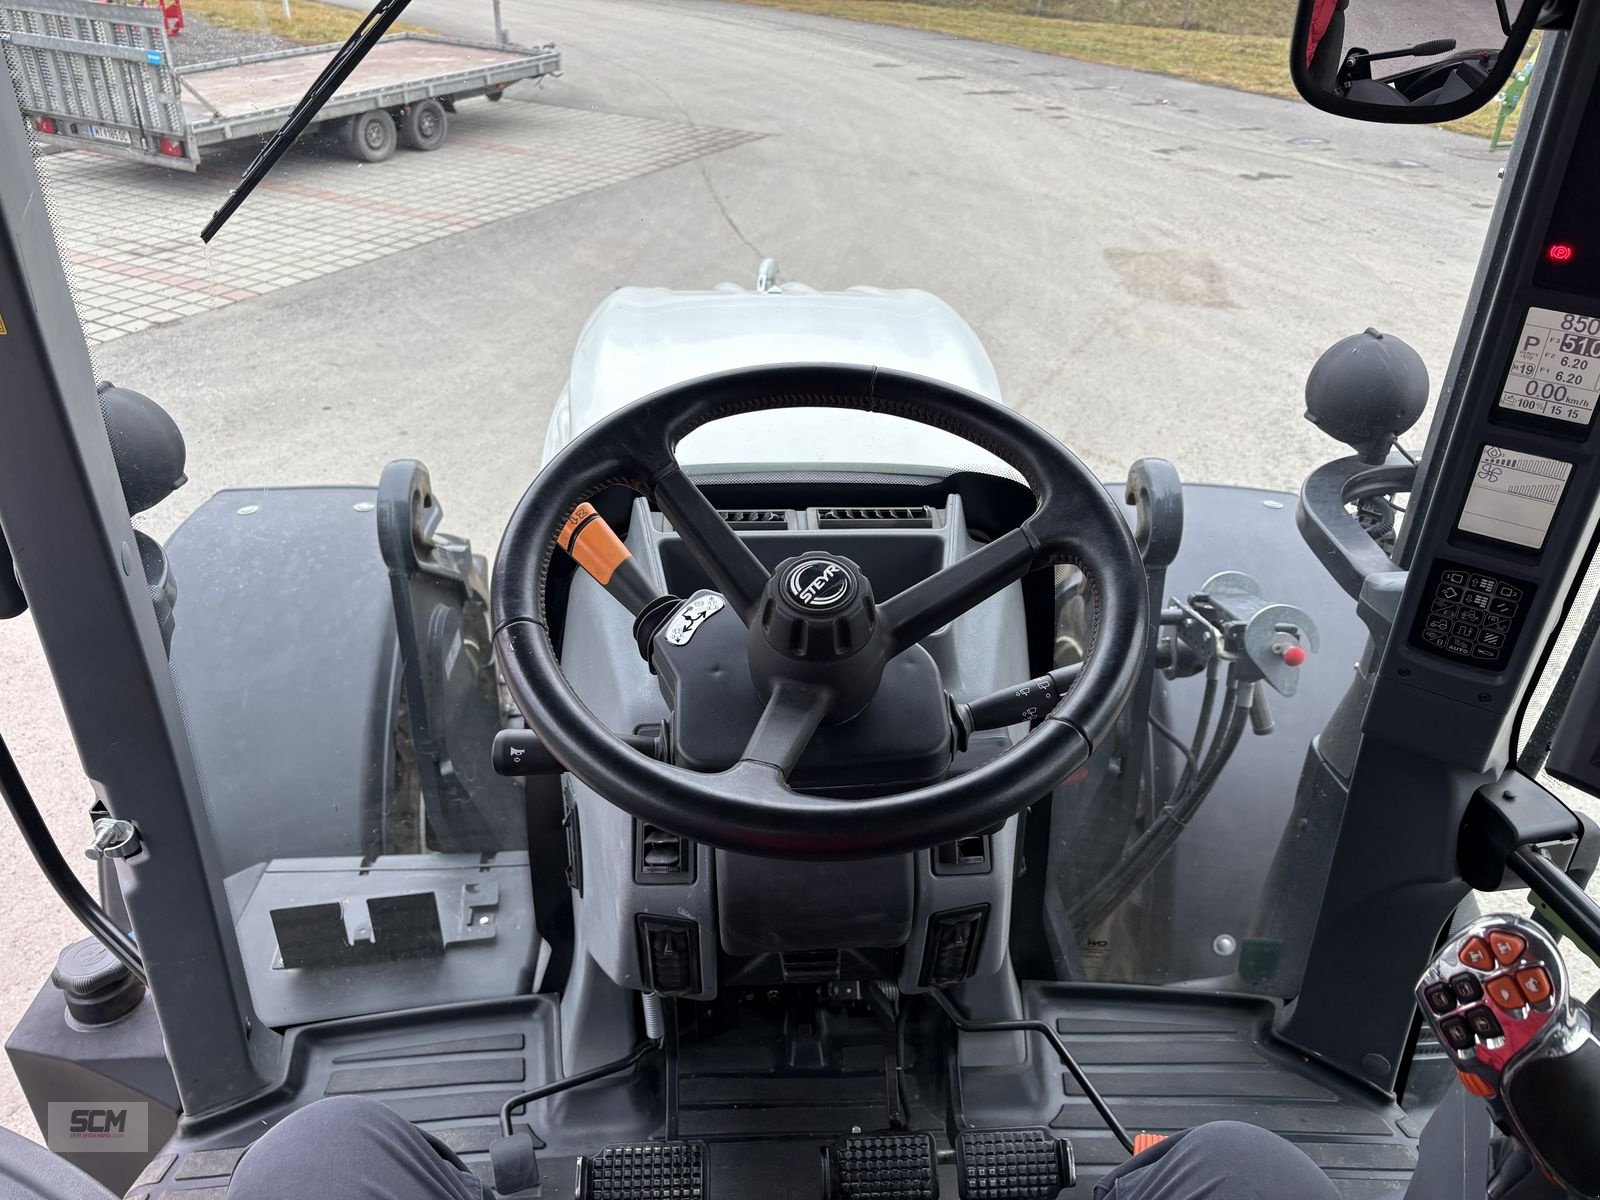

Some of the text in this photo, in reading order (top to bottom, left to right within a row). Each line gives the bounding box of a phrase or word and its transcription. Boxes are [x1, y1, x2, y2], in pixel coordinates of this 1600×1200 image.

[1561, 314, 1600, 335] 850
[1523, 335, 1541, 351] P
[1520, 364, 1534, 376] 19
[1560, 356, 1589, 370] 6.20
[1555, 371, 1583, 385] 6.20
[1525, 380, 1590, 408] 0.00 km/h
[1550, 405, 1580, 420] 15 15
[799, 564, 840, 605] STEYR
[1449, 645, 1468, 654] AUTO
